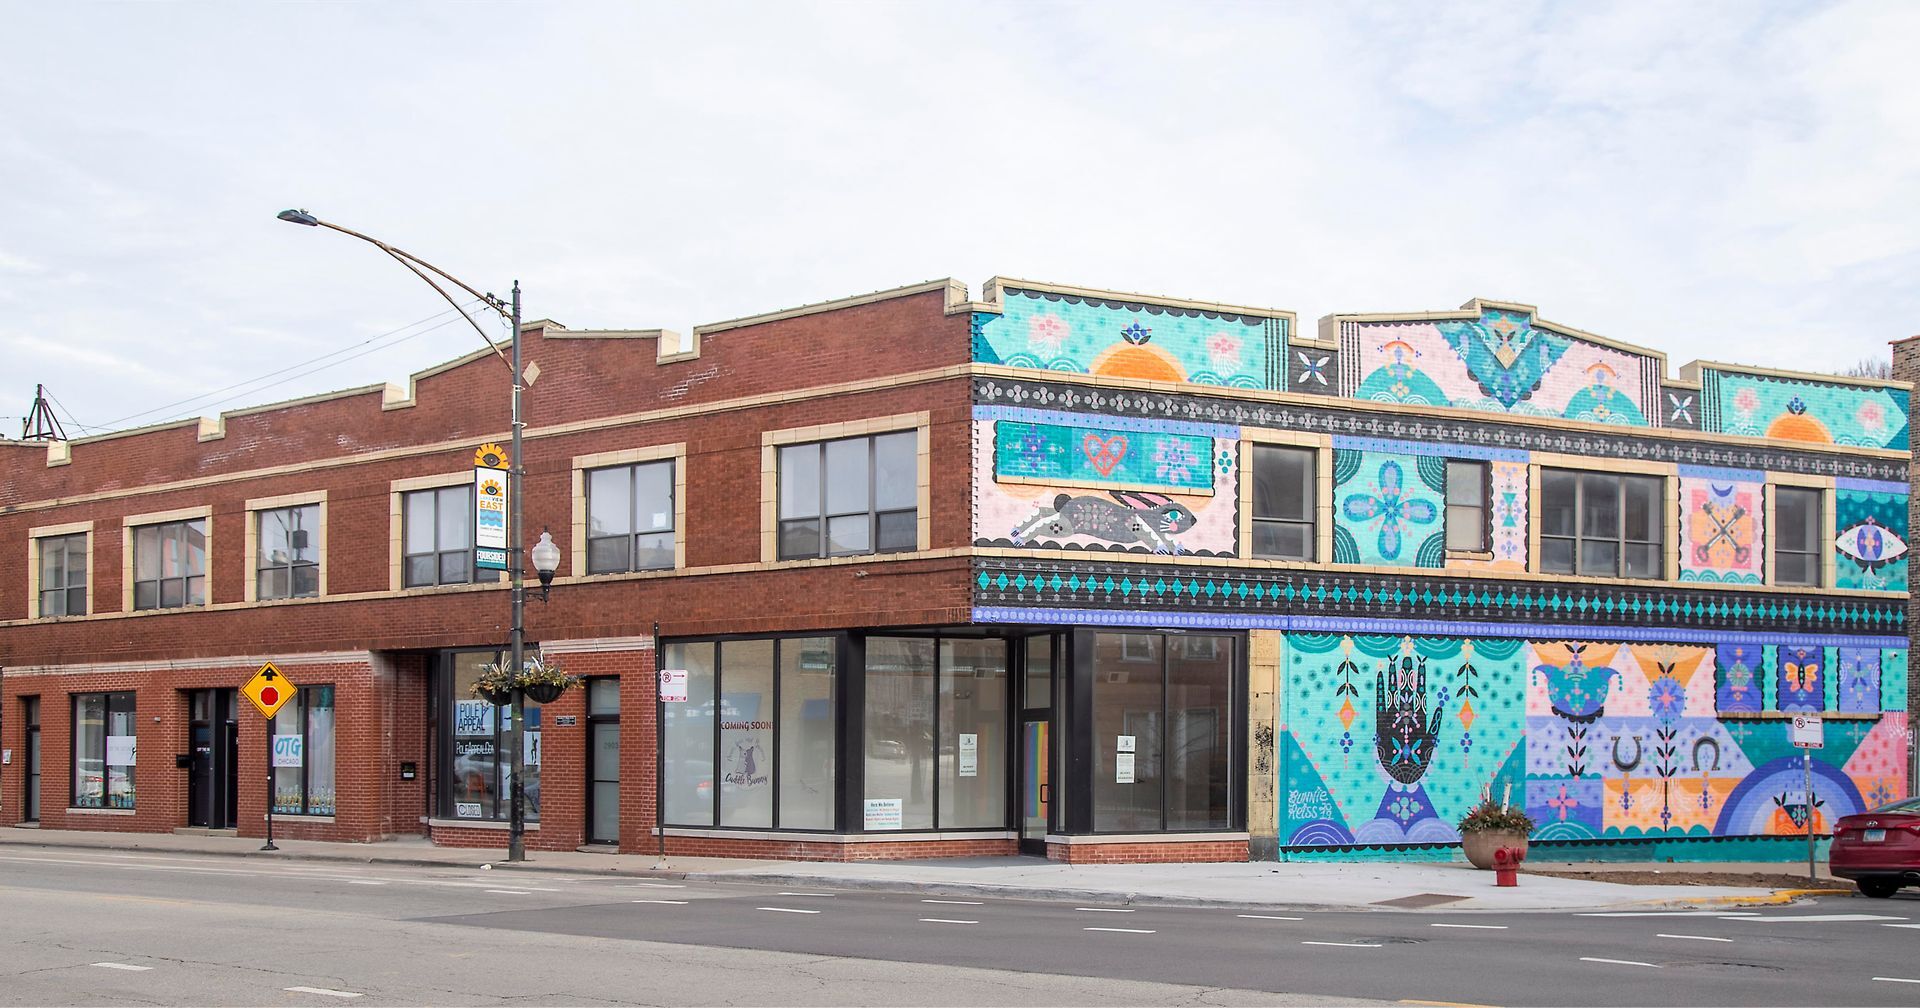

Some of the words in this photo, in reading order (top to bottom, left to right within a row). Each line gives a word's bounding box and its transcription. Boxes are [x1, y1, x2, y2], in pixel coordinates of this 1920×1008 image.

[480, 500, 503, 511] EAST
[460, 702, 480, 718] POLE
[458, 717, 485, 731] APPEAL
[720, 721, 750, 731] COMING
[275, 737, 301, 757] OTG
[725, 773, 745, 785] Cuddle
[746, 774, 768, 786] Bunny
[459, 804, 480, 816] CLOSED
